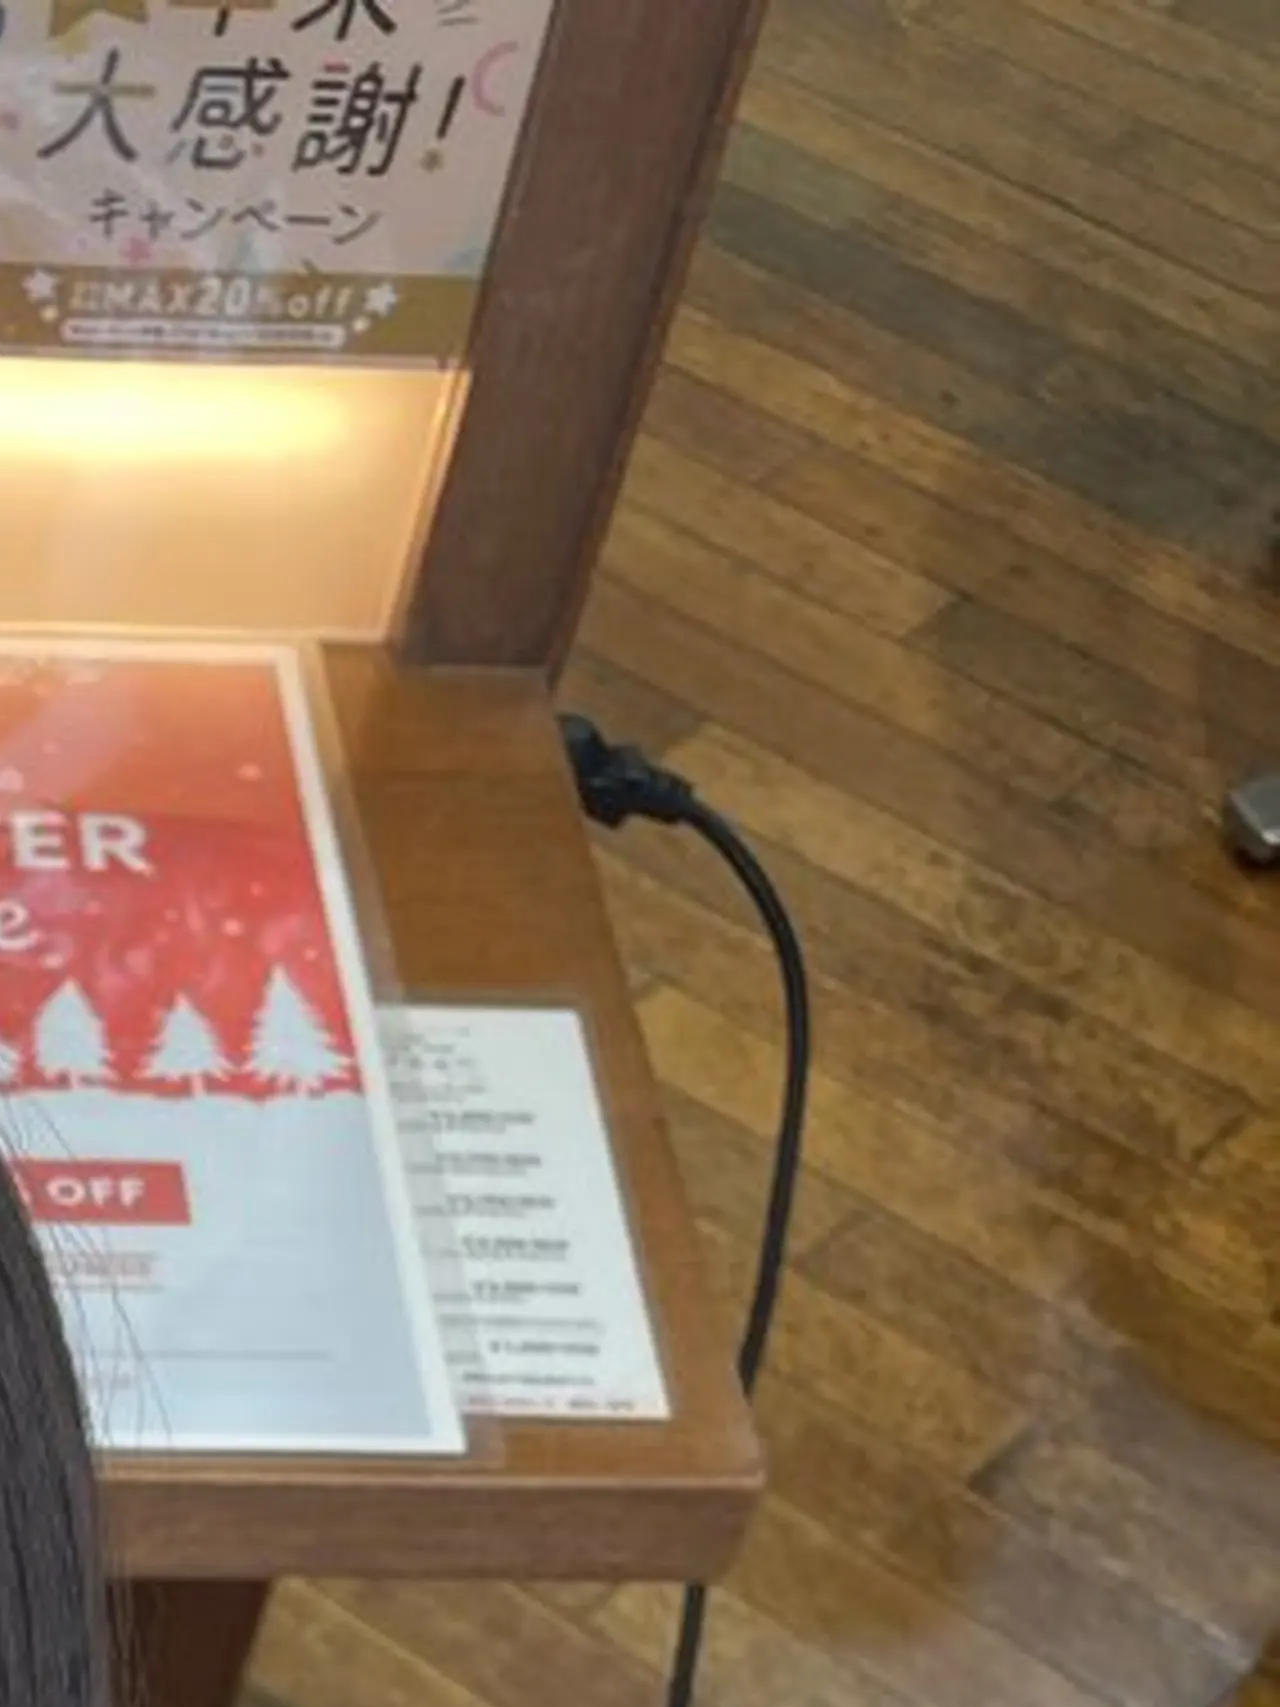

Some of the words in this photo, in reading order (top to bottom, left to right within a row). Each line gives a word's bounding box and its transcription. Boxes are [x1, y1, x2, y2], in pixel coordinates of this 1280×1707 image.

[37, 47, 466, 177] 大感謝!
[89, 188, 382, 246] キャンペーン
[44, 1175, 144, 1208] OFF
